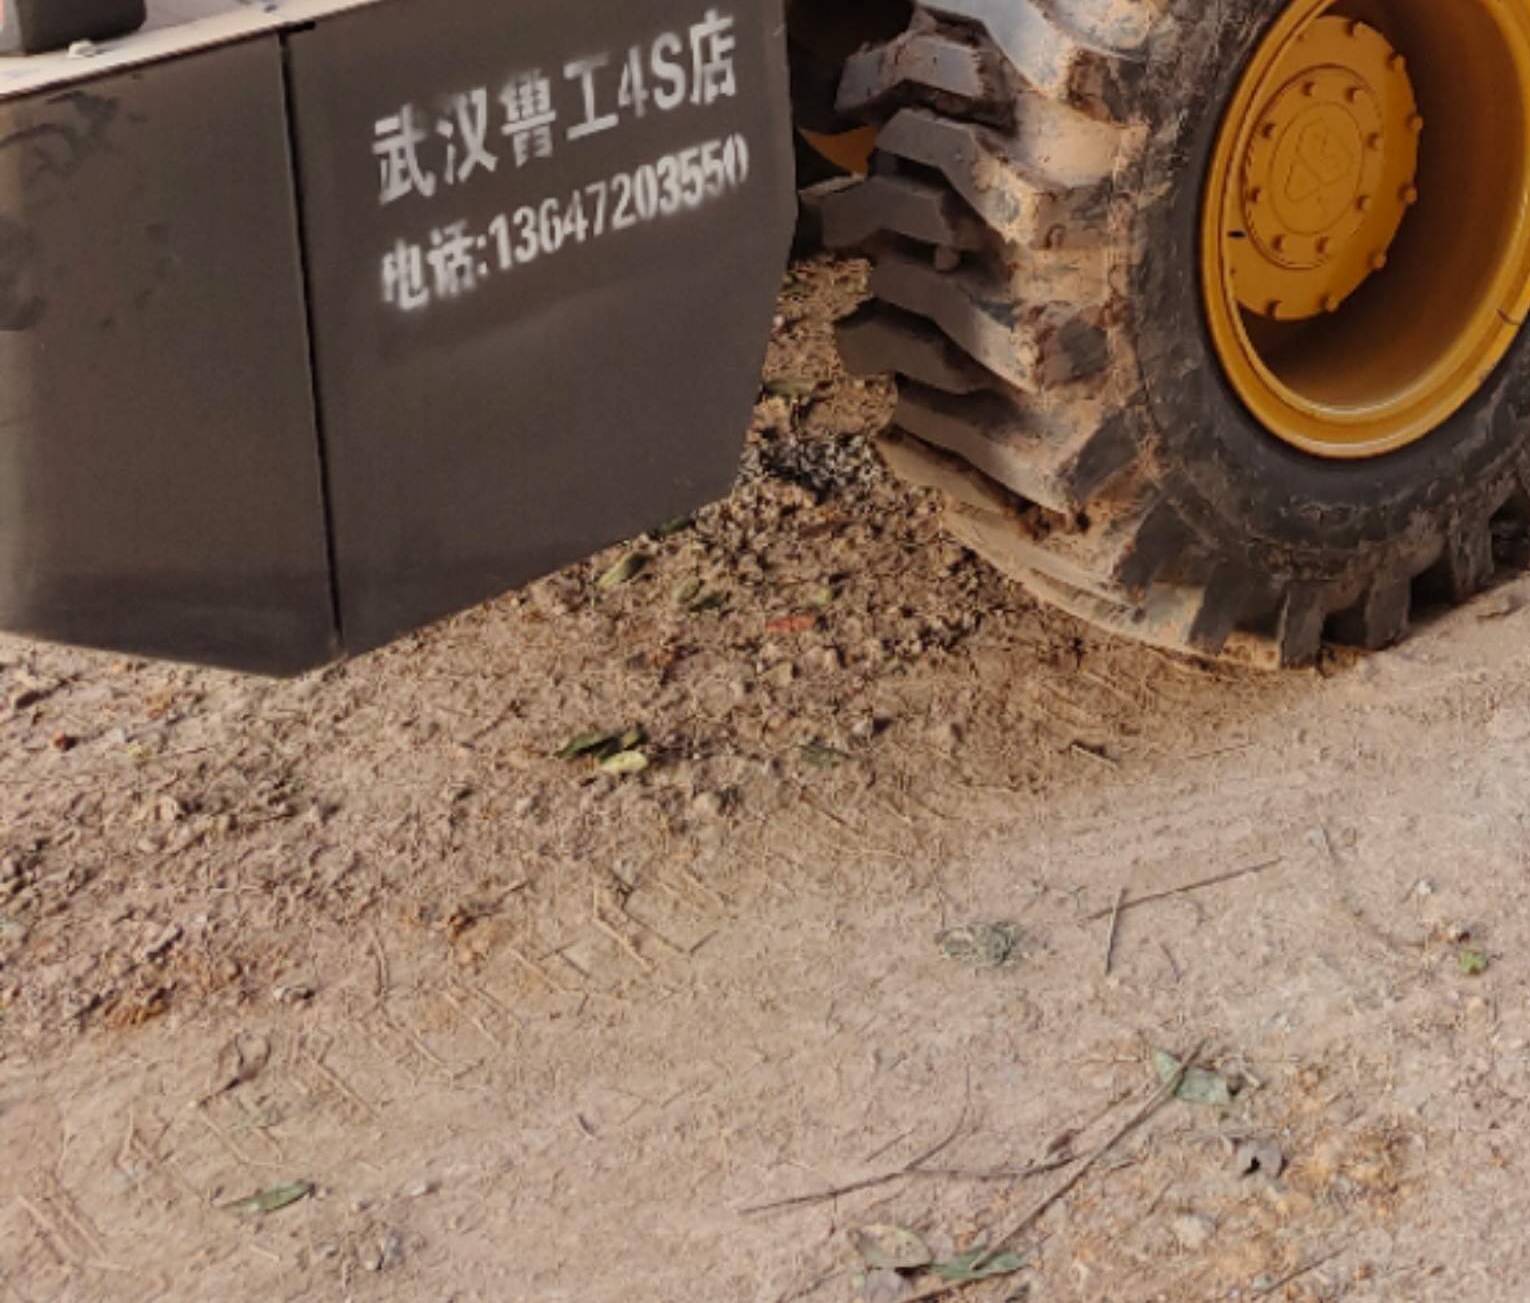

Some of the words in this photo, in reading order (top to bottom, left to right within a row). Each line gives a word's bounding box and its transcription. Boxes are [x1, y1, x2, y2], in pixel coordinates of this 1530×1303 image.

[372, 8, 736, 207] 武汉鲁工4S店
